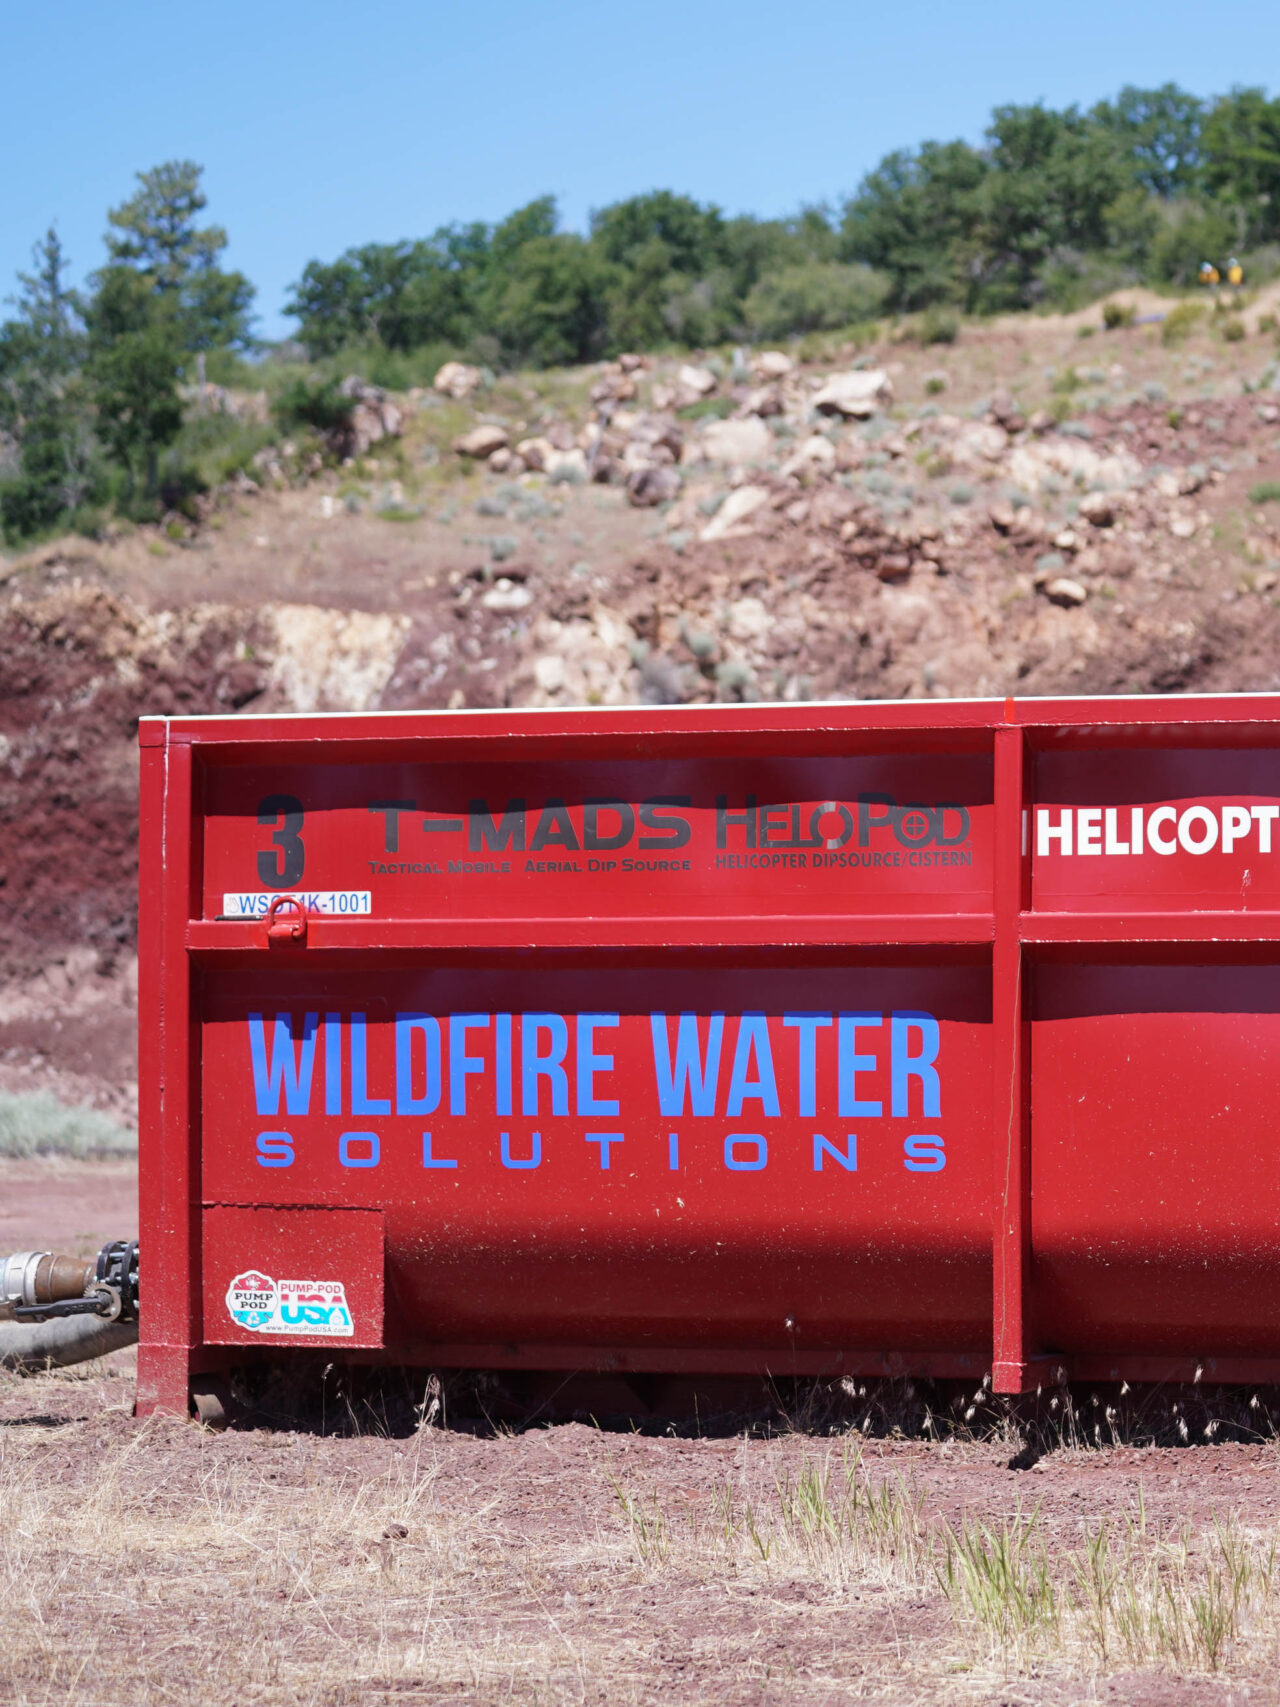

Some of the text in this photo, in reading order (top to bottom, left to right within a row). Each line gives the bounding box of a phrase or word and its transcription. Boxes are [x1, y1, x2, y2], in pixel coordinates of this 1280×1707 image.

[368, 796, 691, 852] T-MADS
[257, 793, 305, 889] 3
[716, 852, 806, 869] HELICOPTER
[248, 1010, 941, 1117] WILDFIRE WATER
[256, 1132, 946, 1172] SOLUTIONS
[235, 1292, 273, 1301] PUMP
[281, 1283, 341, 1294] PUMP-POD
[240, 1301, 267, 1310] POD
[281, 1294, 349, 1326] USA
